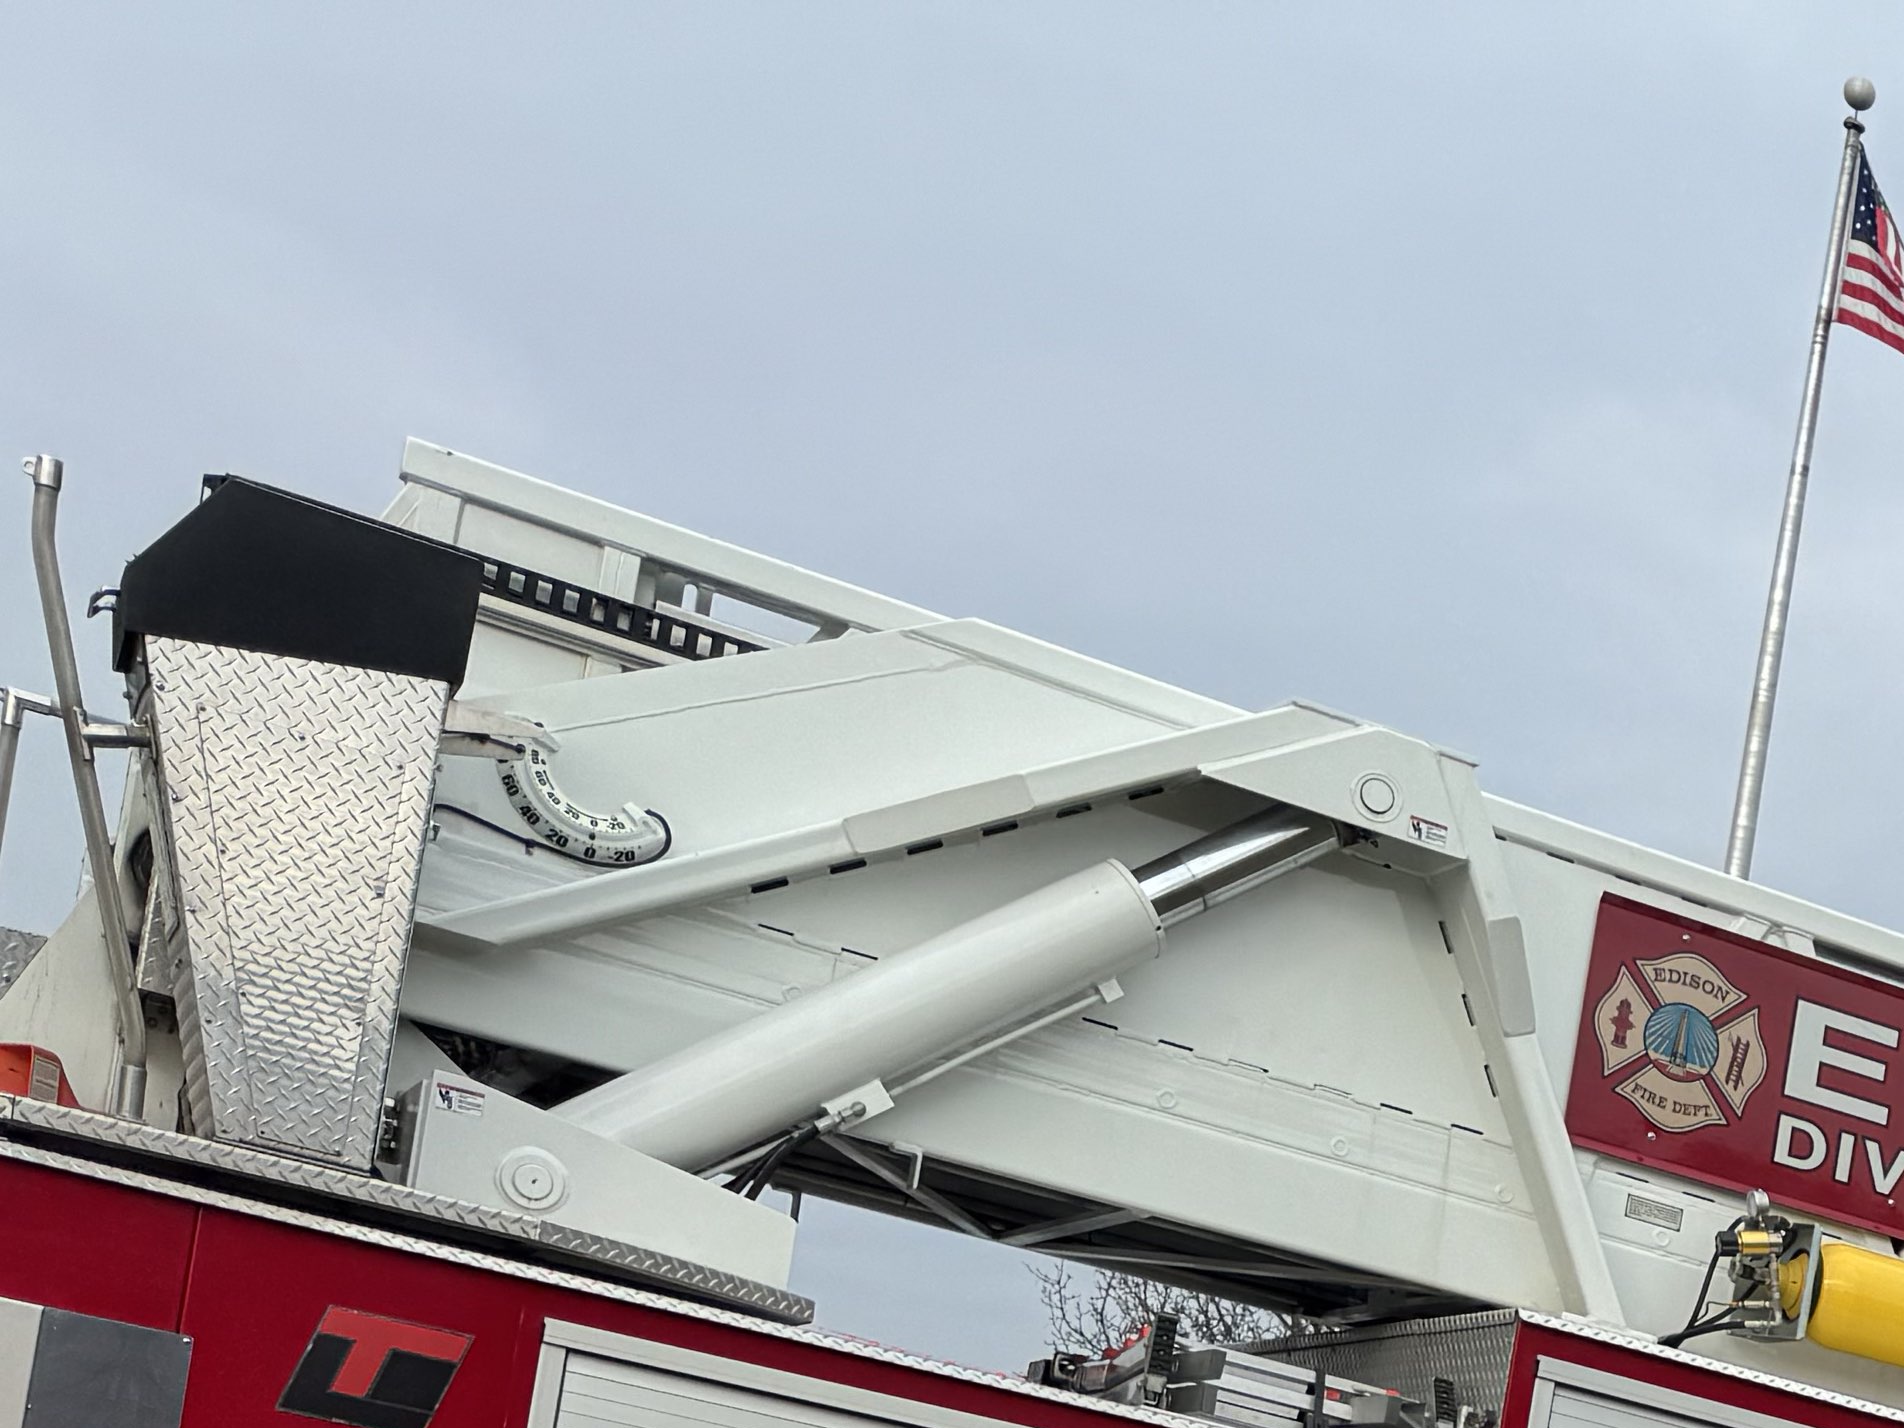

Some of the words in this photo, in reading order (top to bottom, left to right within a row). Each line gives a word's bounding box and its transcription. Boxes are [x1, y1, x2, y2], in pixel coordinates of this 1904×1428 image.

[501, 773, 520, 797] 60
[519, 804, 540, 825] 40
[544, 828, 569, 848] 20
[583, 845, 597, 860] 0
[546, 790, 562, 806] 40
[564, 808, 581, 821] 20
[590, 818, 598, 828] 0
[1652, 966, 1731, 1005] EDISON
[1630, 1081, 1668, 1109] FIRE
